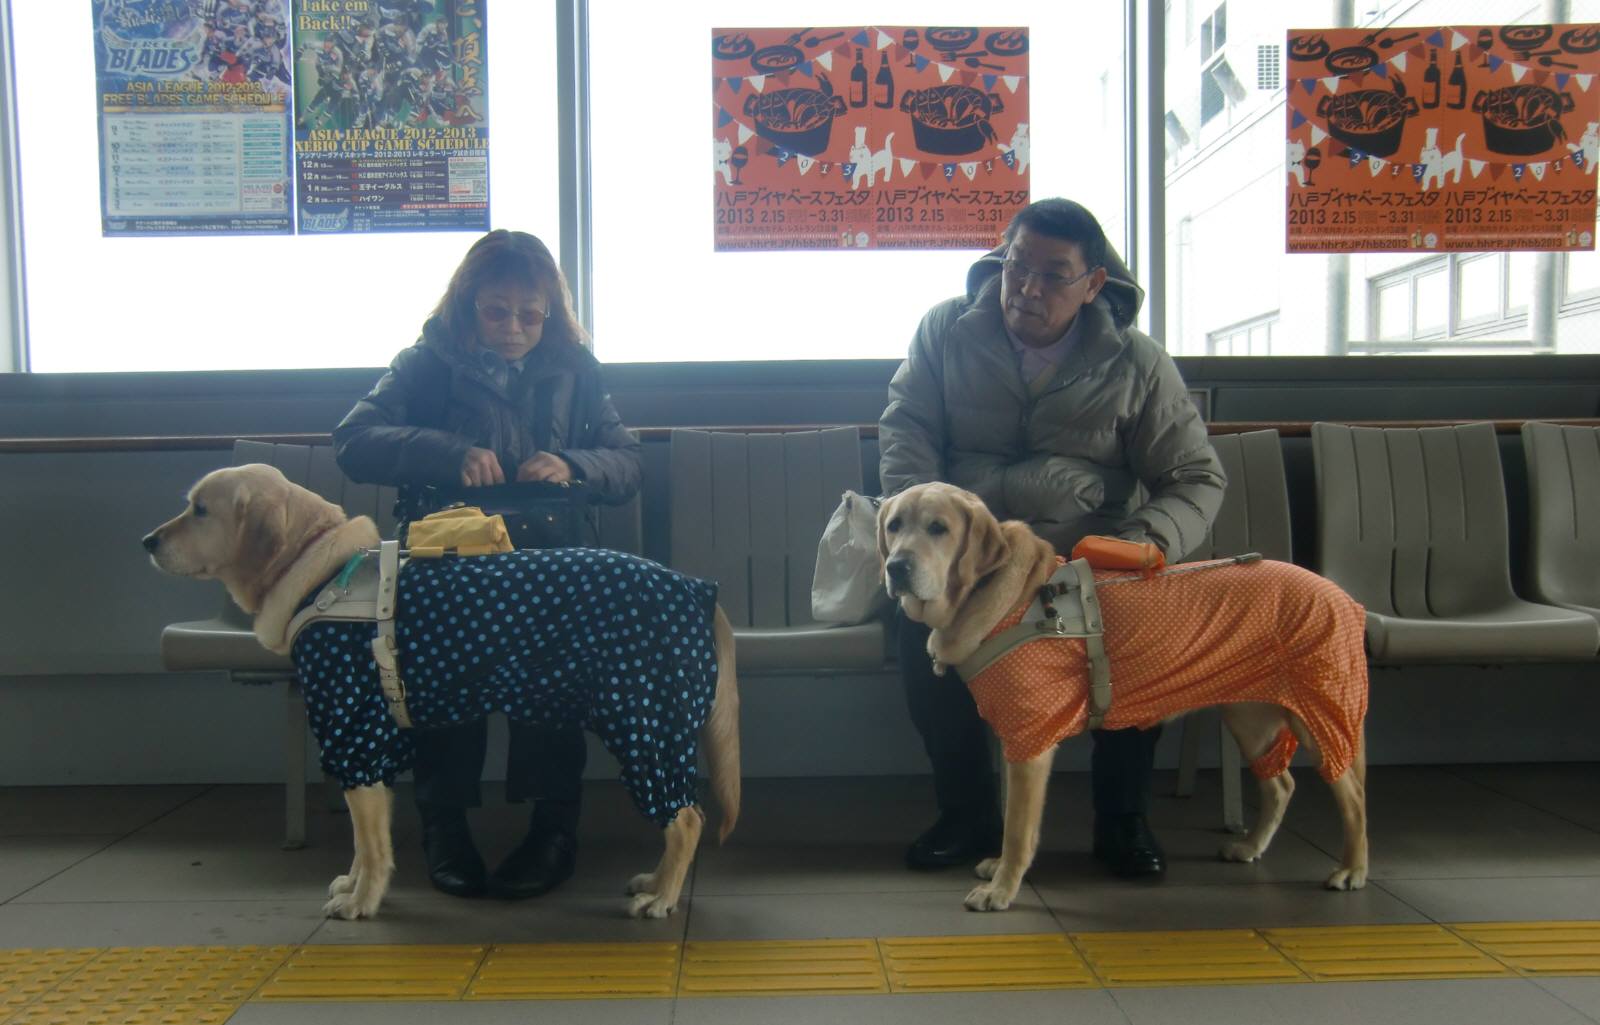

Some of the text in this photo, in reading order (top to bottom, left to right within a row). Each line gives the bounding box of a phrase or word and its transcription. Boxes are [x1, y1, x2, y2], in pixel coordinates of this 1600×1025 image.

[301, 0, 340, 12] Take
[299, 15, 351, 30] Back!!
[108, 48, 196, 73] BLADES
[126, 82, 153, 92] ASIA
[157, 82, 204, 92] LEAGUE
[103, 94, 132, 105] FREE
[186, 93, 222, 105] GAME
[223, 92, 285, 105] SCHEDULE
[403, 127, 477, 139] 2012-2013
[341, 139, 370, 151] CUP
[374, 139, 412, 151] GAME
[717, 187, 870, 206] 八戸ブイヤベースフェスタ
[876, 186, 1028, 205] 八戸ブイヤベースフェスタ
[1289, 188, 1440, 207] 八戸ブイヤベースフェスタ
[1445, 187, 1596, 206] 八戸ブイヤベースフェスタ
[716, 208, 755, 224] 2013
[760, 210, 785, 223] 2.15
[876, 208, 914, 223] 2013
[920, 208, 945, 222] 2.15
[1289, 209, 1326, 225] 2013
[1332, 211, 1356, 224] 2.15
[1445, 208, 1482, 223] 2013
[1488, 210, 1513, 223] 2.15
